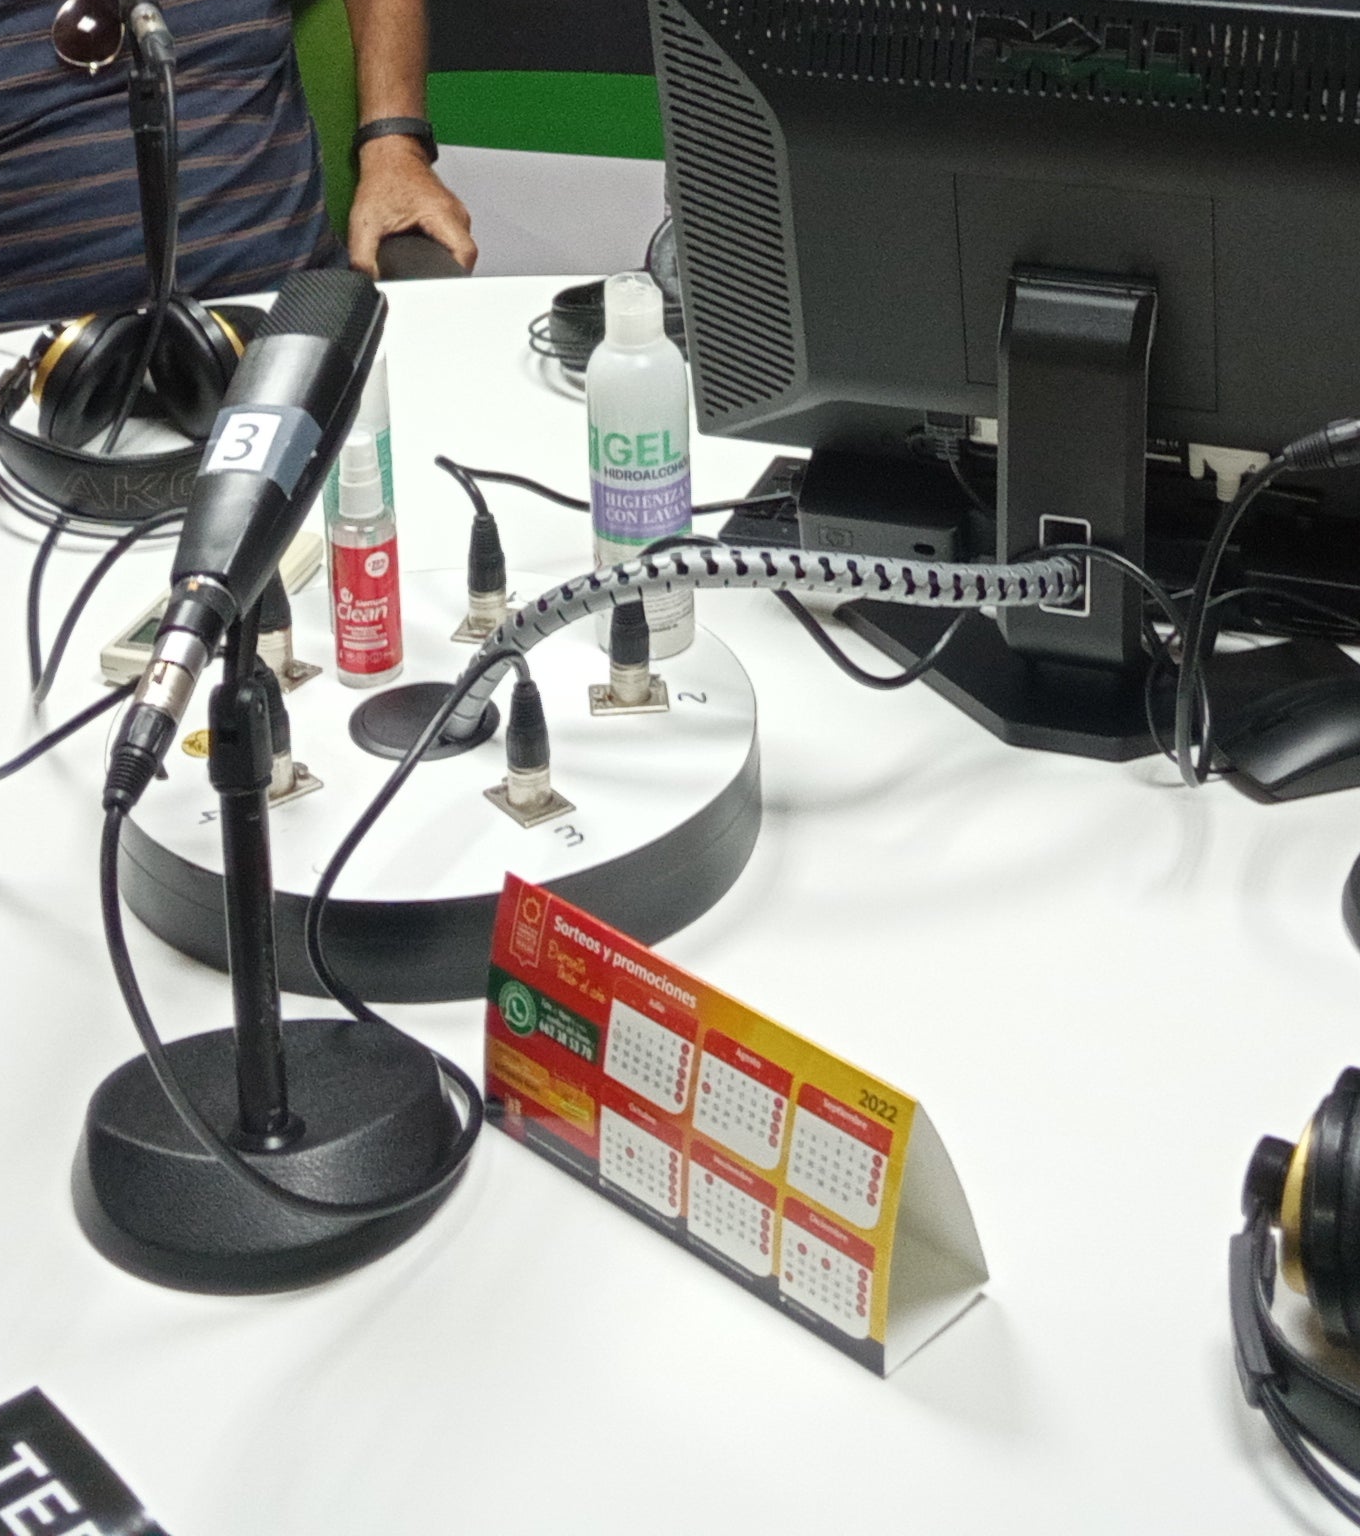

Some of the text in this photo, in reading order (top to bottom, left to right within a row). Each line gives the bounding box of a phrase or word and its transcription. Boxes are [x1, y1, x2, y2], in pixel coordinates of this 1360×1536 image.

[222, 423, 260, 462] 3
[603, 430, 681, 467] GEL
[605, 507, 638, 524] CON
[553, 914, 601, 955] Sorteos
[602, 945, 612, 963] y
[612, 951, 698, 1010] promociones
[858, 1088, 899, 1124] 2022
